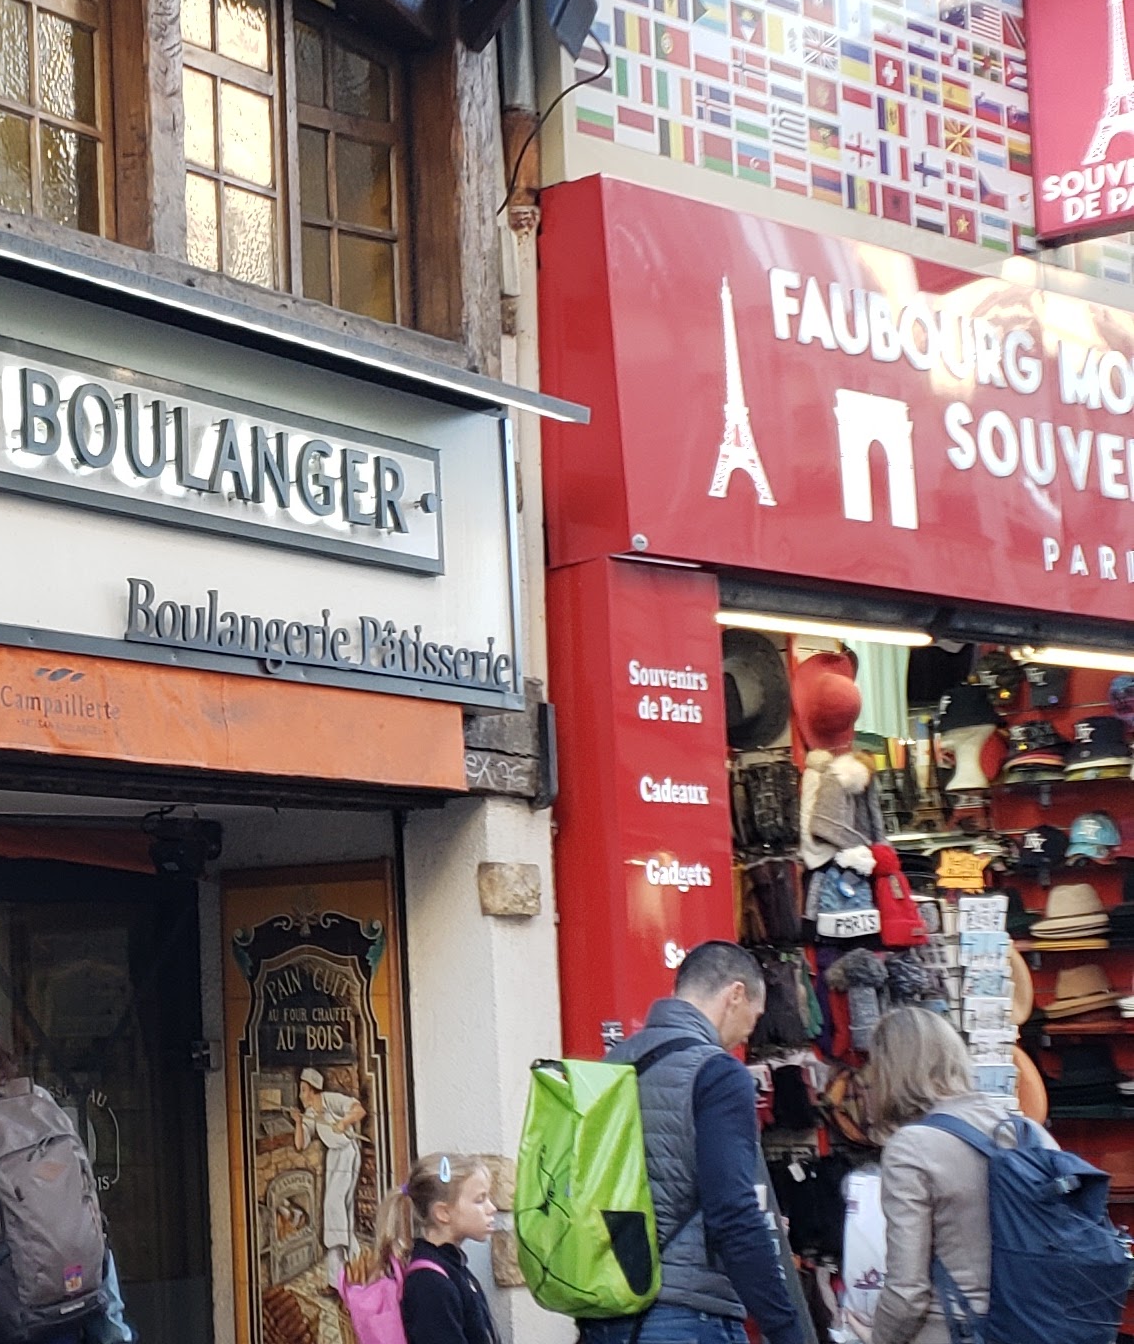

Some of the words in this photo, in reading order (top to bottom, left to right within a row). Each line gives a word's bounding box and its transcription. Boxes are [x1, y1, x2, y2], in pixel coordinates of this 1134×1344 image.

[1063, 191, 1102, 224] DE
[769, 267, 1042, 395] FAUBOURG
[1059, 340, 1134, 414] MO
[19, 367, 409, 534] BOULANGER
[126, 577, 351, 674] Boulangerie
[359, 615, 511, 688] Pâtisserie
[628, 659, 709, 691] Souvenirs
[638, 695, 659, 721] de
[660, 696, 702, 724] Paris
[639, 775, 709, 805] Cadeaux
[645, 859, 711, 892] Gadgets
[266, 966, 303, 1006] PAIN
[284, 1008, 307, 1022] FOUR
[276, 1025, 296, 1051] AU
[306, 1024, 344, 1051] BOIS
